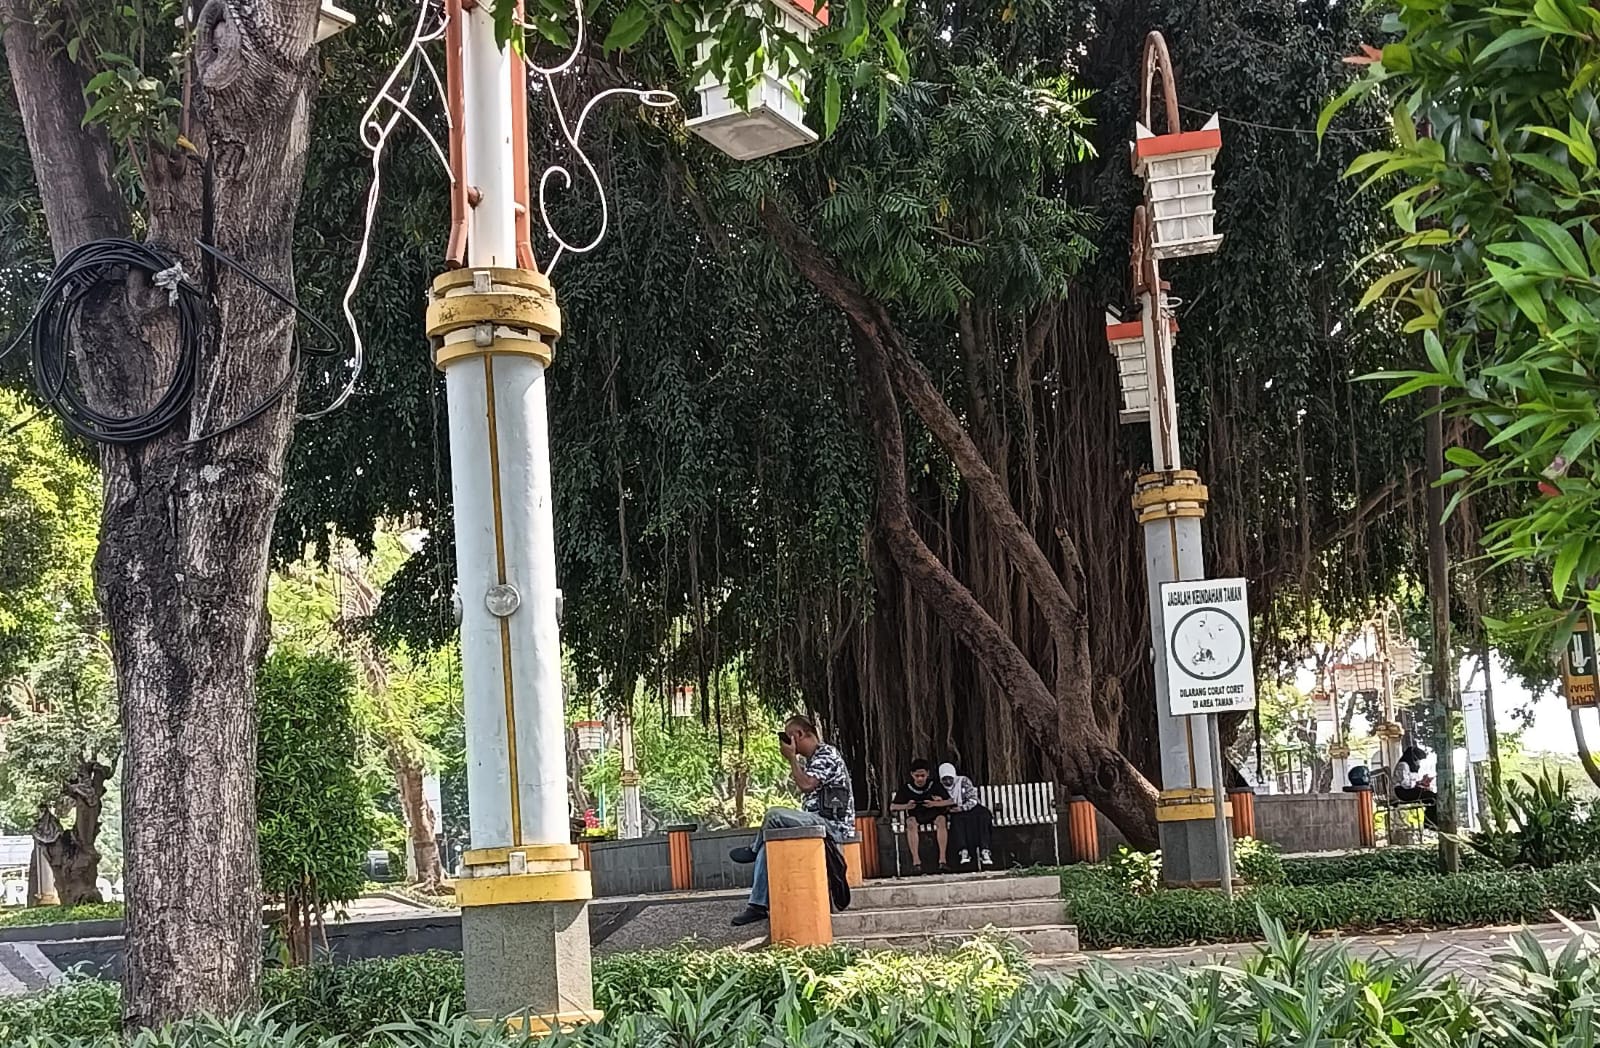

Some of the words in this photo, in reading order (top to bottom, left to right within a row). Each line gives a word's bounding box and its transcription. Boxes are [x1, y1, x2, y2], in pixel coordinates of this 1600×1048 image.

[1223, 586, 1242, 602] TAMAN
[1180, 687, 1206, 698] DILARANG
[1208, 685, 1225, 696] CORAT
[1226, 684, 1244, 694] CORET
[1193, 700, 1198, 708] DI
[1200, 698, 1213, 707] AREA
[1215, 697, 1233, 706] TAMAN
